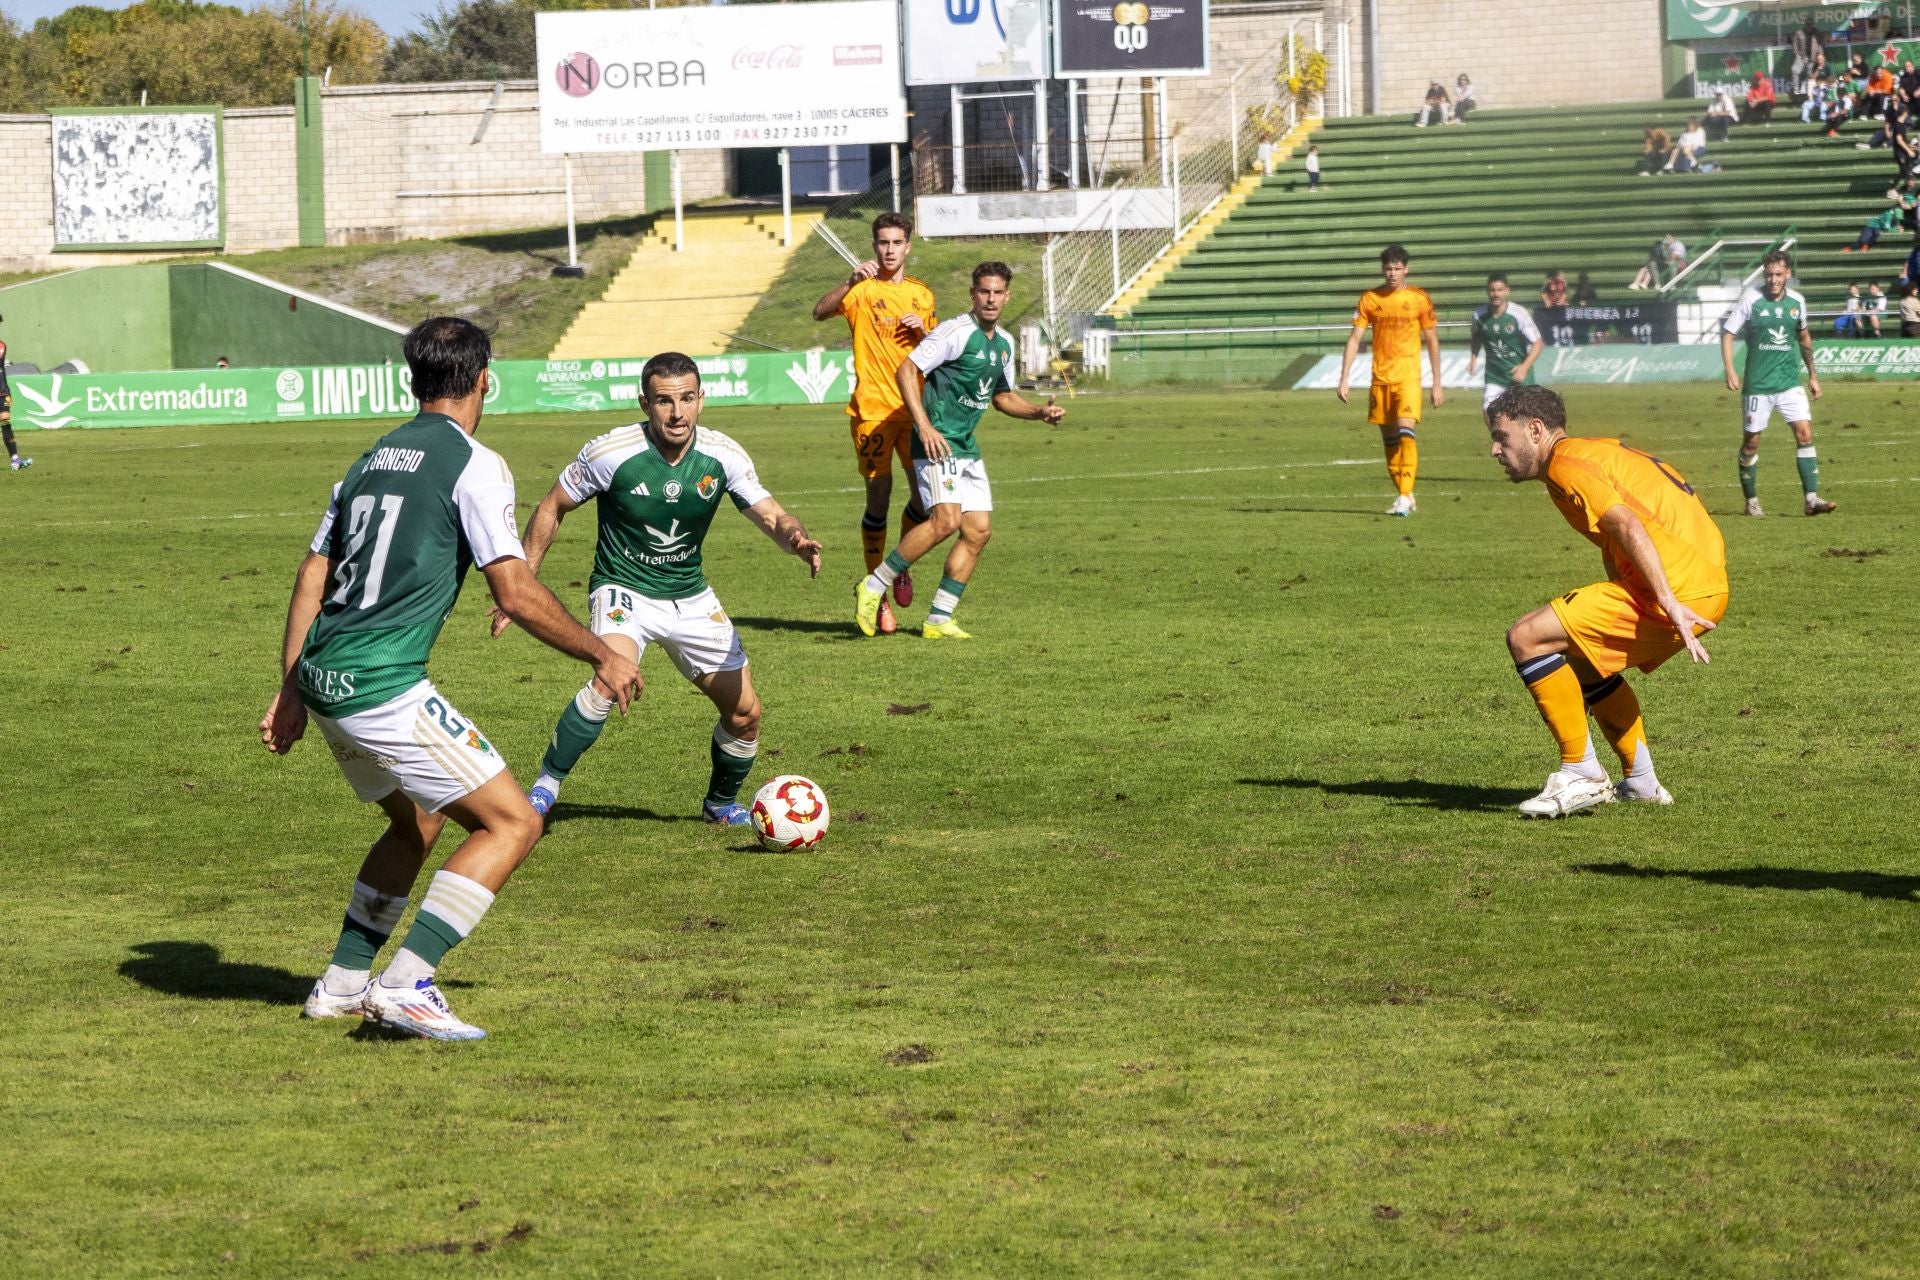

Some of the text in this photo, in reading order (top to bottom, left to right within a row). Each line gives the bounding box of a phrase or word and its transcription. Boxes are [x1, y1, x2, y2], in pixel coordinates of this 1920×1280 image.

[1814, 6, 1892, 23] PROVINCIA
[563, 58, 706, 92] NORBA
[573, 115, 618, 127] Industrial
[620, 115, 635, 126] Las
[771, 113, 793, 122] nave
[795, 110, 802, 121] 3
[810, 109, 838, 121] 10005
[841, 106, 889, 119] CÁCERES
[636, 131, 662, 143] 927
[667, 129, 692, 142] 113
[697, 128, 721, 141] 100
[734, 127, 760, 141] FAX
[763, 127, 789, 140] 927
[793, 126, 818, 139] 230
[823, 124, 849, 137] 727
[546, 361, 582, 372] DIEGO
[1804, 346, 1839, 364] OS
[1838, 346, 1885, 364] SIETE
[535, 371, 593, 383] ALVARADO
[86, 382, 248, 414] Extremadura
[311, 366, 419, 415] IMPULS
[859, 434, 885, 457] 22
[369, 446, 425, 473] SANCHO
[940, 458, 957, 476] 18
[331, 493, 405, 610] 21
[624, 543, 697, 566] Extremadura
[607, 588, 634, 613] 19
